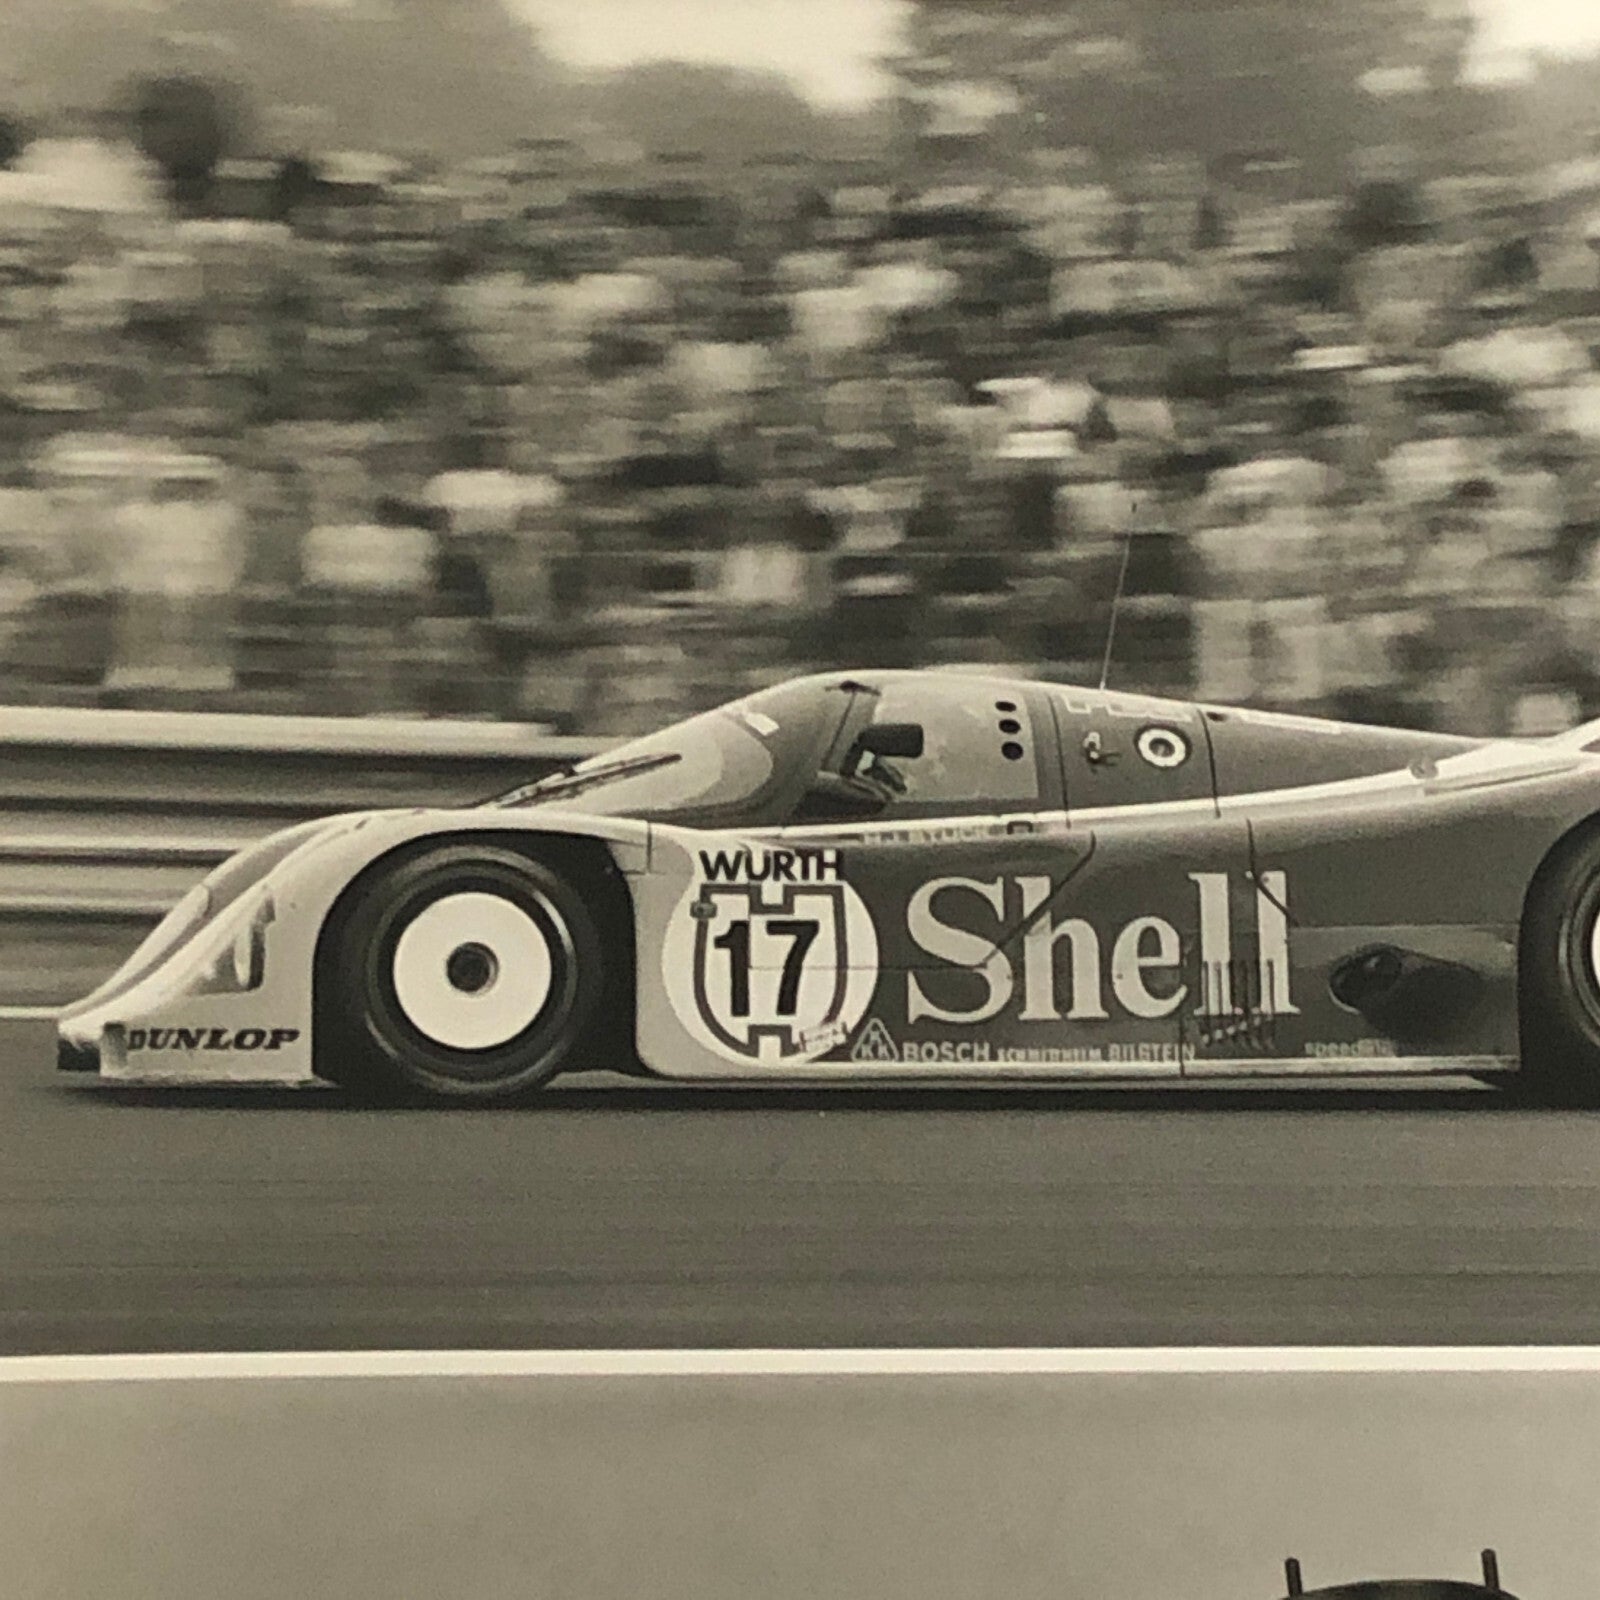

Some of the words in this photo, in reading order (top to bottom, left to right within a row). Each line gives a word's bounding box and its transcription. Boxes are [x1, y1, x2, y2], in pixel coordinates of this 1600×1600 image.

[714, 920, 820, 1017] 17
[907, 871, 1300, 1024] Shell
[127, 1028, 299, 1050] DUNLOP
[903, 1042, 990, 1062] BOSCH
[1108, 1042, 1195, 1061] BILSTEIN
